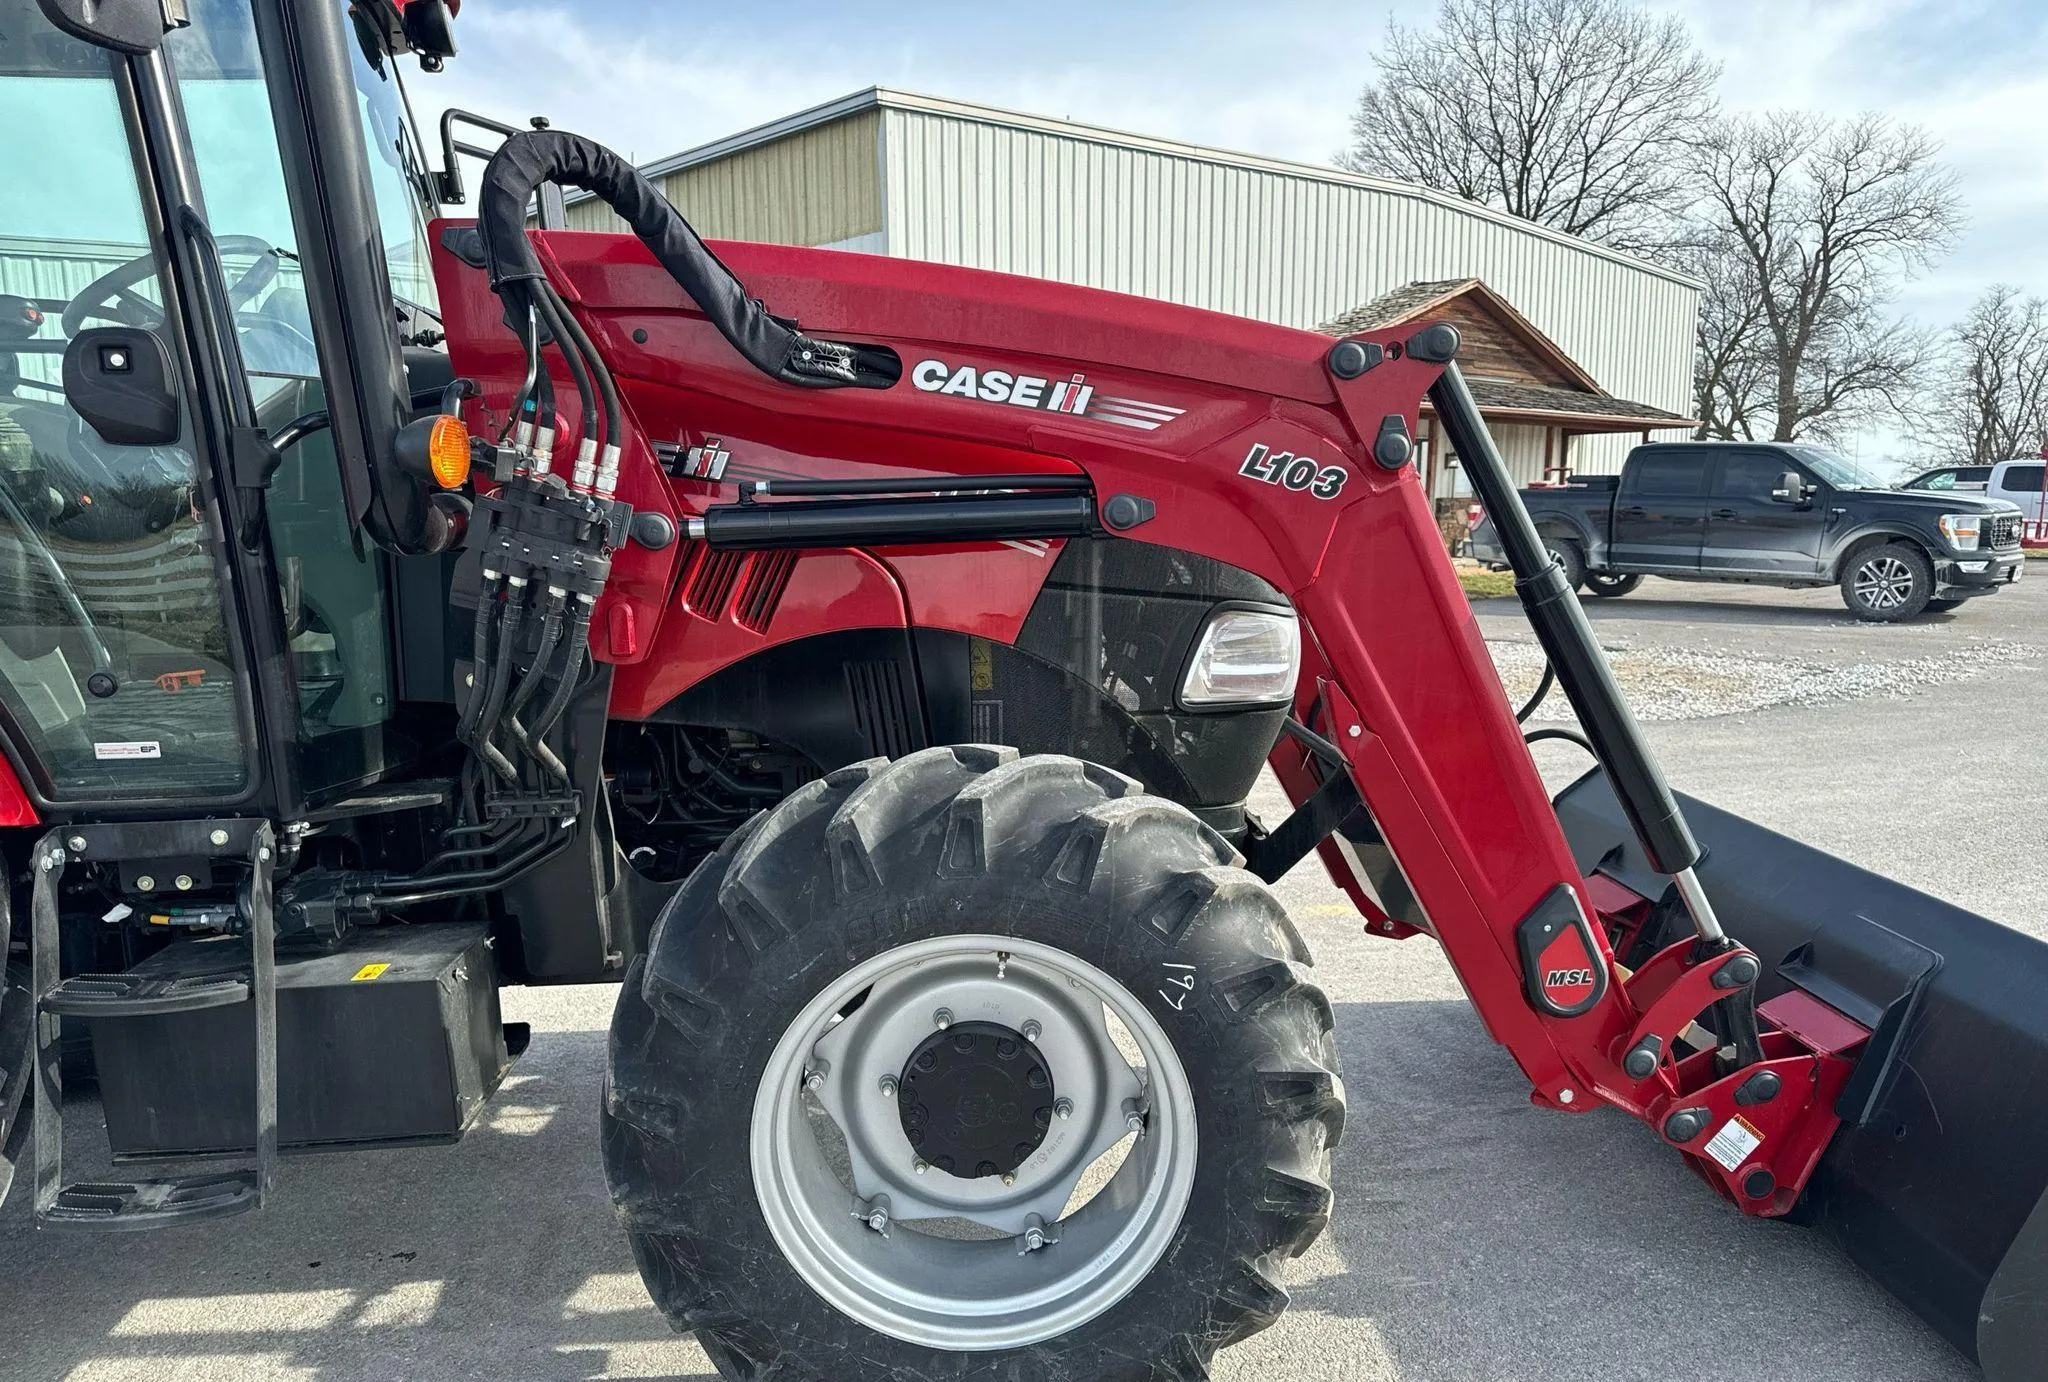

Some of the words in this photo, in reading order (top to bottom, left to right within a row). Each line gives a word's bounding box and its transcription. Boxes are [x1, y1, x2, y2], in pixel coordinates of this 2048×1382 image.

[911, 359, 1048, 408] CASE
[1237, 442, 1349, 500] L103
[1545, 968, 1594, 988] MSL
[1737, 1116, 1765, 1142] WARNING
